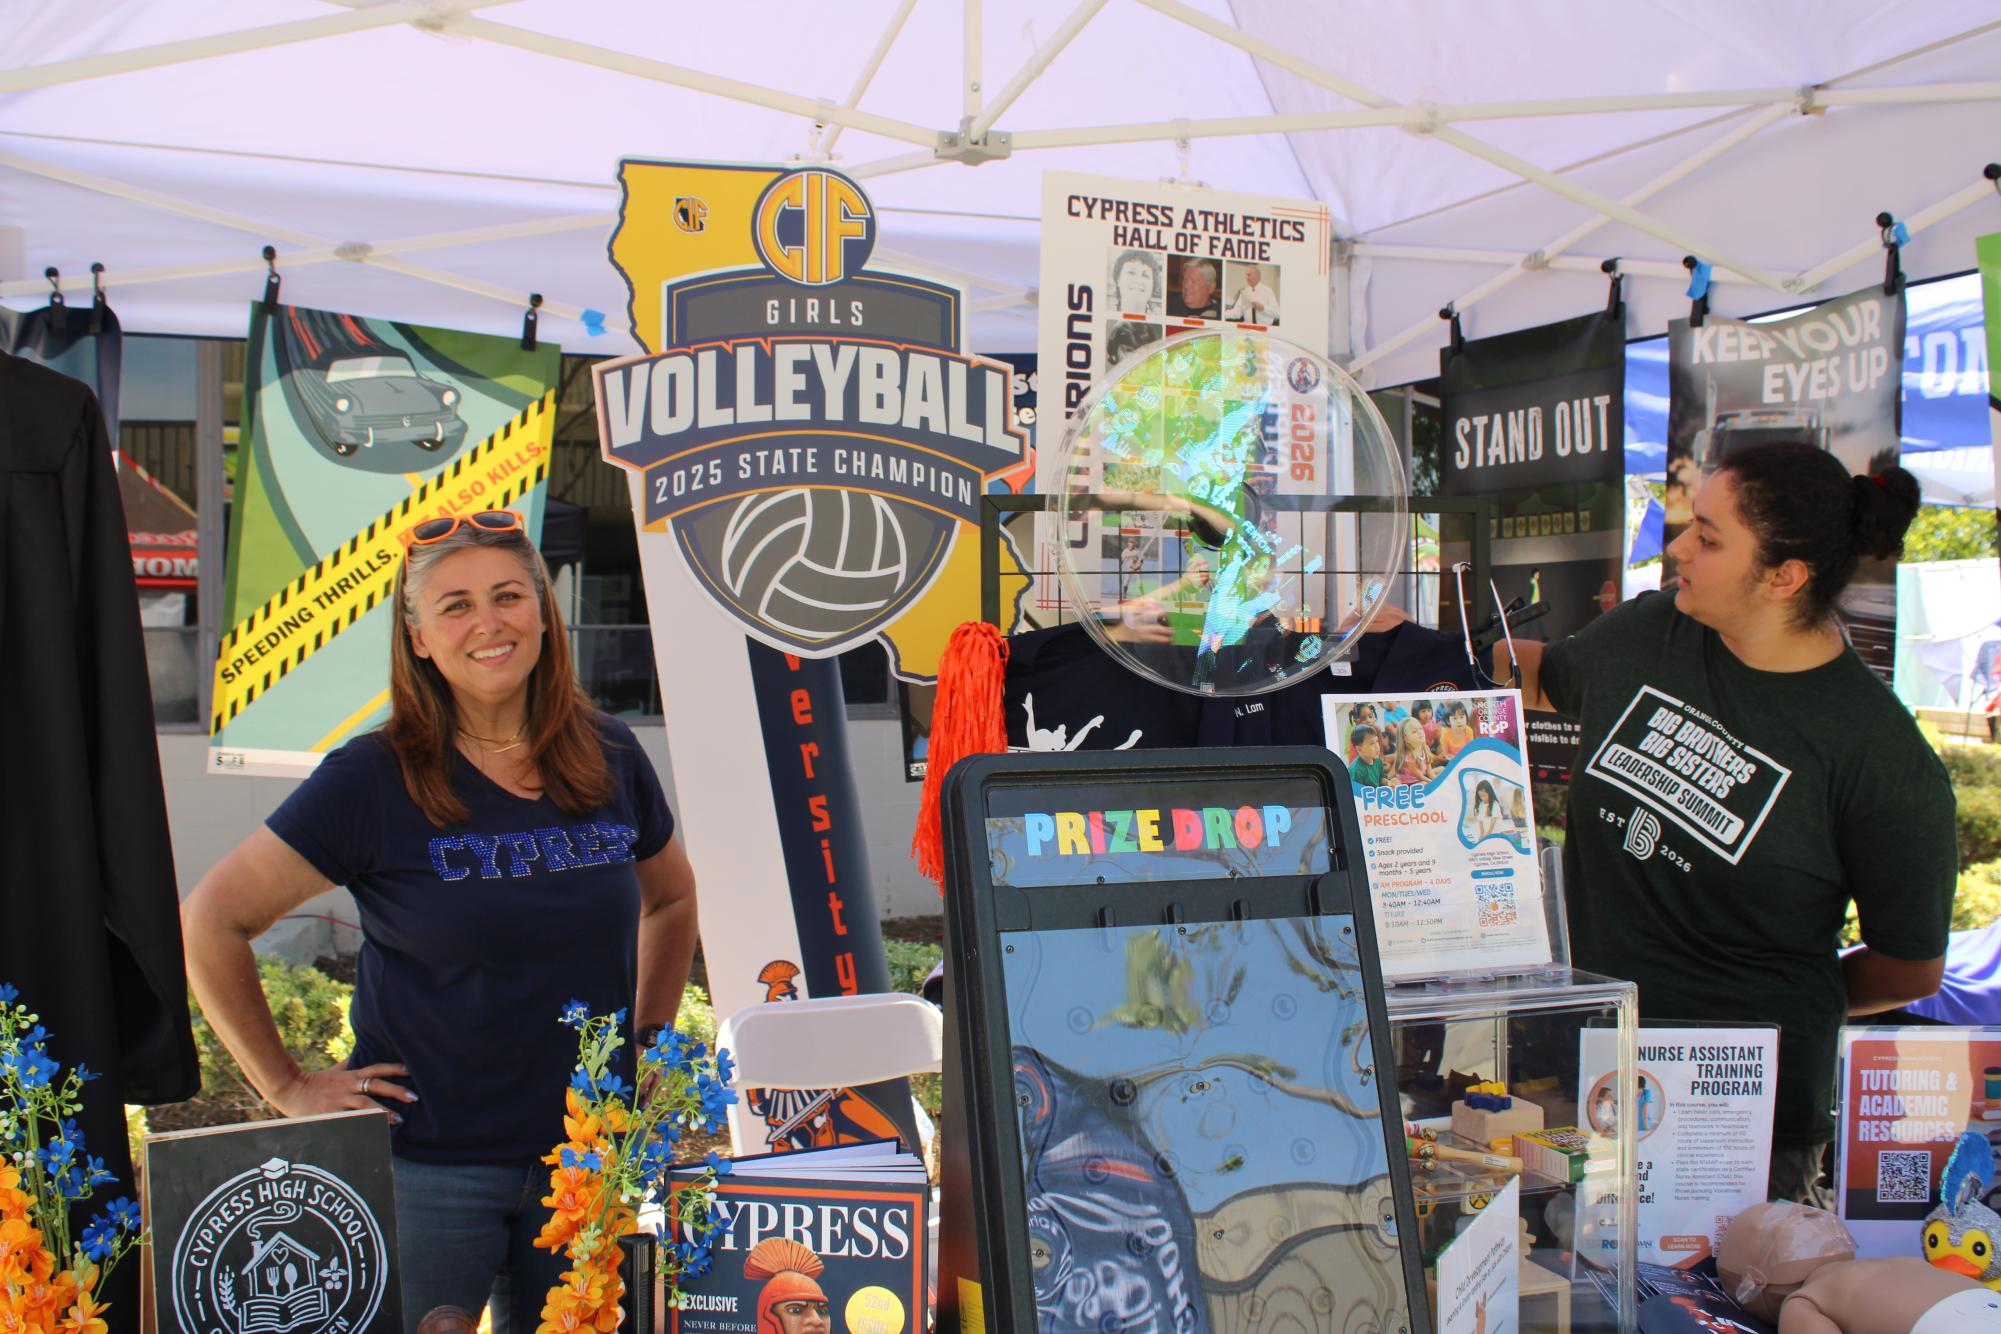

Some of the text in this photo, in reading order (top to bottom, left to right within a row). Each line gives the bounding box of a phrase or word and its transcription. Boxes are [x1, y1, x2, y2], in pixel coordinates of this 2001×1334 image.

[755, 171, 871, 285] CIF
[1067, 194, 1306, 242] CYPRESS ATHLETICS
[1113, 226, 1271, 261] HALL OF FAME
[766, 299, 864, 326] GIRLS
[1772, 300, 1881, 359] YOUR
[1763, 355, 1841, 404] EYES
[1849, 346, 1889, 393] UP
[604, 342, 1020, 455] VOLLEYBALL
[1290, 403, 1316, 482] 2026
[1455, 395, 1611, 470] STAND OUT
[438, 444, 548, 518] ALSO KILLS.
[655, 447, 973, 507] 2025 STATE CHAMPION
[221, 548, 399, 685] SPEEDING THRILLS.
[1245, 702, 1265, 714] Lam
[1477, 700, 1507, 709] NOTH
[1478, 708, 1508, 716] ORNGE
[1479, 720, 1509, 735] ROP
[1530, 735, 1558, 745] visible
[1560, 736, 1569, 745] to
[1531, 721, 1562, 732] clothes
[1563, 723, 1573, 732] to
[1711, 719, 1745, 749] COUNTY
[1647, 706, 1757, 784] BIG BROTHERS
[1638, 730, 1736, 800] BIG SISTERS
[1361, 784, 1426, 812] FREE
[1607, 749, 1735, 836] LEADERSHIP SUMMIT
[1024, 805, 1293, 856] PRIZE DROP
[1363, 810, 1448, 827] PRESCHOOL
[1396, 847, 1424, 857] provided
[1600, 807, 1626, 828] EST
[1659, 845, 1693, 873] 2026
[1378, 862, 1393, 870] Ages
[1418, 860, 1431, 868] and
[1415, 867, 1432, 876] years
[1380, 881, 1391, 889] AM
[1391, 880, 1423, 888] PROGRAM
[1638, 1046, 1764, 1062] NURSE ASSISTANT
[1696, 1063, 1764, 1079] TRAINING
[1860, 1069, 1958, 1091] TUTORING &
[1690, 1080, 1763, 1096] PROGRAM
[1859, 1095, 1949, 1117] ACADEMIC
[1858, 1120, 1956, 1142] RESOURCES
[190, 1180, 367, 1267] CYPRESS HIGH SCHOOL
[683, 1199, 910, 1260] CYPRESS
[684, 1295, 738, 1313] EXCLUSIVE
[864, 1293, 891, 1312] 52nd
[684, 1320, 757, 1333] NEVER BEFORE
